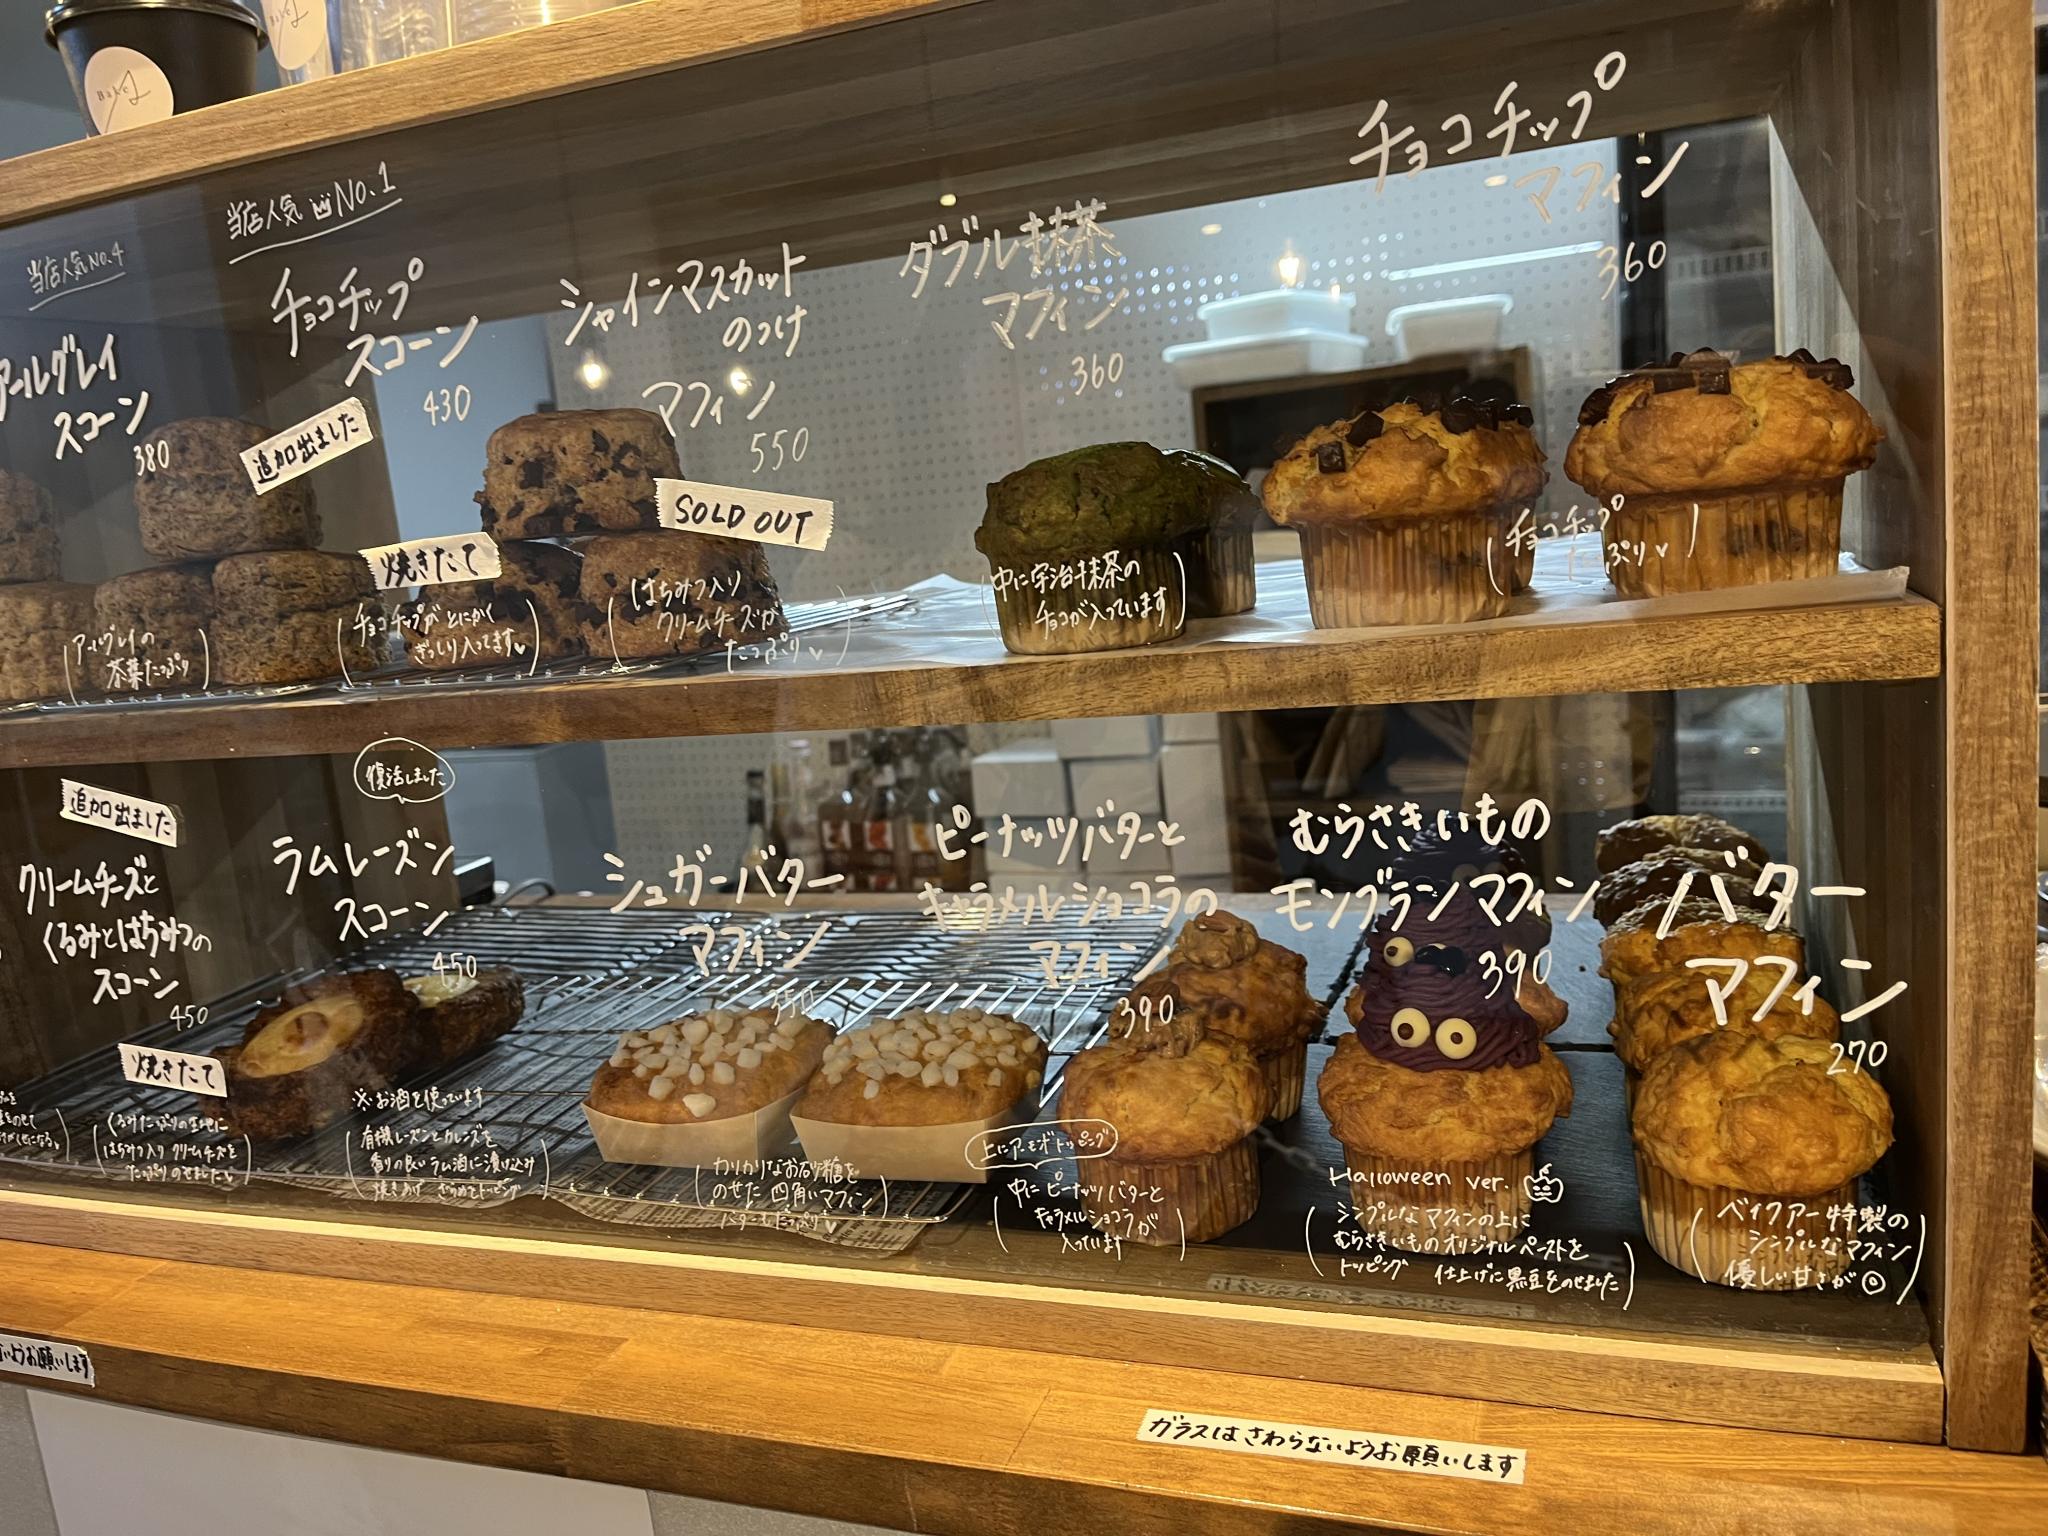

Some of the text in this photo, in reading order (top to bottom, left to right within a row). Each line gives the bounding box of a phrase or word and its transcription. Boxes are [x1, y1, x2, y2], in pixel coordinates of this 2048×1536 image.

[1349, 51, 1627, 193] チョコチップ
[227, 161, 396, 240] 当店人気 No.1
[1514, 141, 1689, 223] マフィン
[899, 198, 1122, 298] ダブル抹茶
[1596, 240, 1666, 300] 360
[270, 257, 425, 358] チョコチップ
[560, 242, 807, 346] シャインマスカット
[982, 286, 1129, 349] マフィン
[344, 315, 479, 387] スコーン
[722, 304, 808, 357] のっけ
[1071, 352, 1124, 395] 360
[54, 391, 149, 460] スコーン
[423, 384, 471, 426] 430
[641, 381, 776, 437] マフィン
[133, 440, 169, 476] 380
[252, 413, 360, 484] 追加出ました
[750, 427, 809, 473] 550
[675, 494, 814, 544] SOLD OUT
[380, 544, 479, 587] 焼きたて
[632, 570, 741, 611] はちみつ入り
[991, 550, 1140, 602] 中に宇治抹茶の
[656, 603, 783, 642] クリームチーズが
[1035, 586, 1167, 640] チョコが入っています
[725, 632, 800, 674] たっぷり
[366, 762, 446, 791] 復活しました
[70, 787, 171, 837] 追加出ました
[936, 799, 1185, 865] ピーナッツバターと
[1289, 793, 1551, 859] むらさきいもの
[19, 854, 159, 915] クリームチーズと
[272, 827, 455, 895] ラムレーズン
[603, 843, 845, 914] シュガーバター
[917, 875, 1218, 933] キャラメルショコラの
[1656, 846, 1866, 940] バター
[43, 909, 212, 965] くるみとはちみつの
[334, 898, 449, 941] スコーン
[432, 952, 477, 988] 450
[679, 921, 832, 977] マフィン
[1029, 940, 1171, 989] マフィン
[1479, 949, 1552, 999] 390
[93, 967, 179, 1004] スコーン
[1685, 955, 1908, 1025] マフィン
[170, 1004, 208, 1031] 450
[1118, 994, 1174, 1038] 390
[131, 1051, 216, 1089] 焼きたて
[1827, 1040, 1888, 1075] 270
[713, 1156, 860, 1184] カリカリなお砂糖を
[1329, 1166, 1509, 1191] Halloween ver.
[1034, 1208, 1159, 1238] キャラメルショコラが
[1061, 1233, 1122, 1260] 入っています
[1749, 1229, 1912, 1261] シンプルなマフィン
[1149, 1414, 1519, 1479] ガラスはさわらないようお願いします
